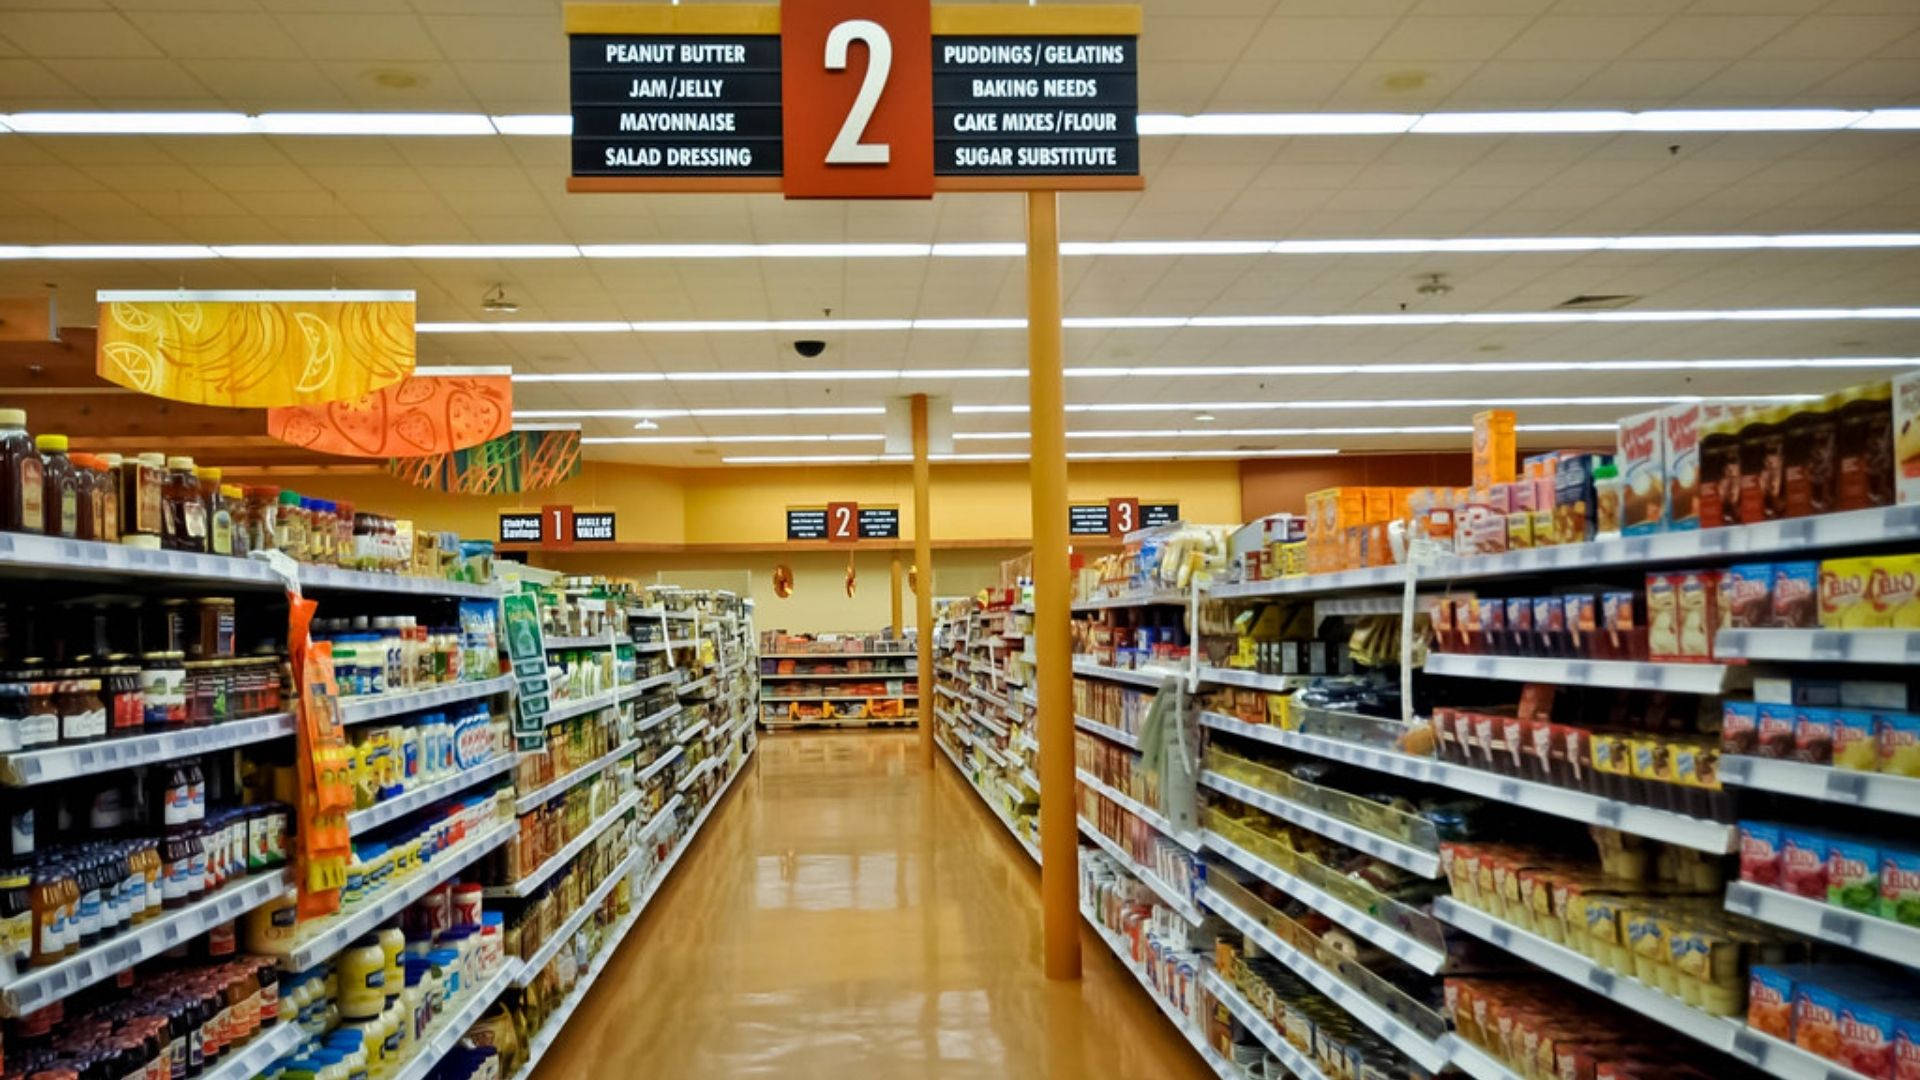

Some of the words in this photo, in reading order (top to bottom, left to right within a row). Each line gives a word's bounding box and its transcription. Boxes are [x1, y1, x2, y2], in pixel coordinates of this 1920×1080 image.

[606, 43, 676, 64] PEANUT
[680, 44, 746, 64] BUTTER
[629, 76, 723, 100] JAM/JELLY
[824, 19, 892, 165] 2
[972, 78, 1040, 98] BAKING
[1043, 78, 1098, 98] NEEDS
[619, 112, 736, 132] MAYONNAISE
[953, 112, 998, 132] CAKE
[605, 146, 662, 167] SALAD
[667, 146, 752, 167] DRESSING
[955, 145, 1013, 166] SUGAR
[1017, 145, 1117, 166] SUBSTITUTE
[553, 510, 562, 541] 1
[835, 507, 851, 537] 2
[1117, 502, 1133, 533] 3
